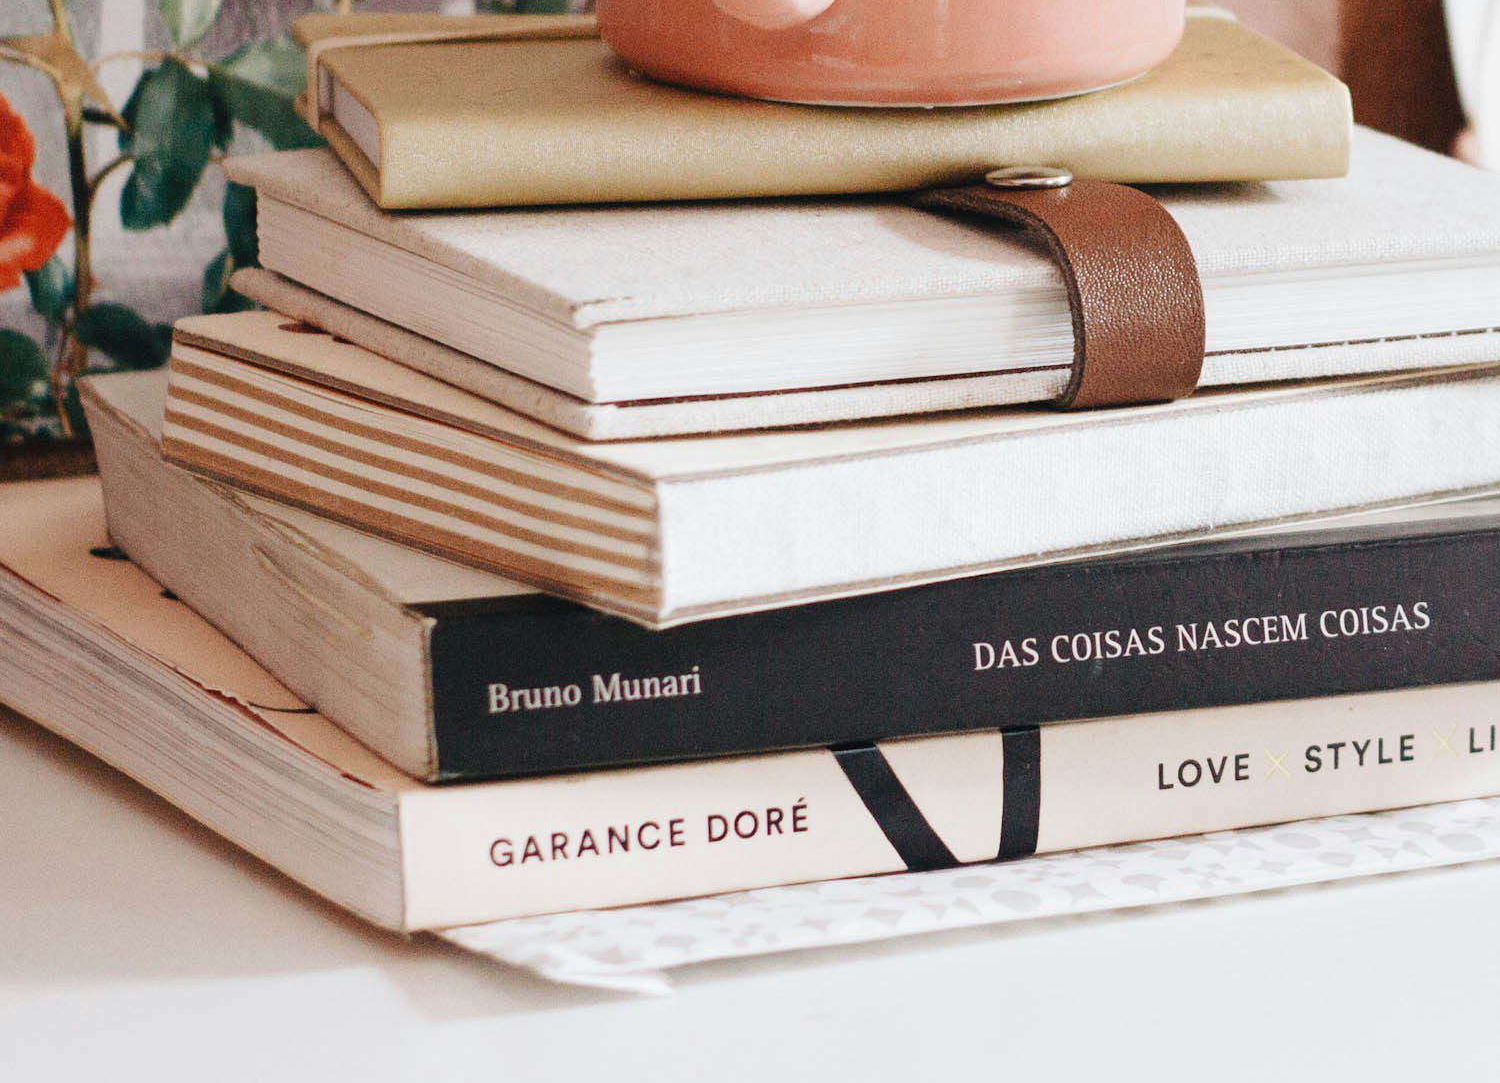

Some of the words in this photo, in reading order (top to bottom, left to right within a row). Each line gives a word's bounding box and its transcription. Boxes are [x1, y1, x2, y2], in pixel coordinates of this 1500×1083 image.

[973, 637, 1040, 671] DAS
[1051, 625, 1165, 663] COISAS
[1176, 613, 1309, 651] NASCEM
[1319, 601, 1431, 639] COISAS
[487, 682, 582, 713] Bruno
[592, 665, 702, 704] Munari
[1157, 753, 1250, 791] LOVE
[1304, 734, 1415, 773] STYLE
[489, 818, 686, 868] GARANCE
[706, 797, 809, 843] DORÉ
